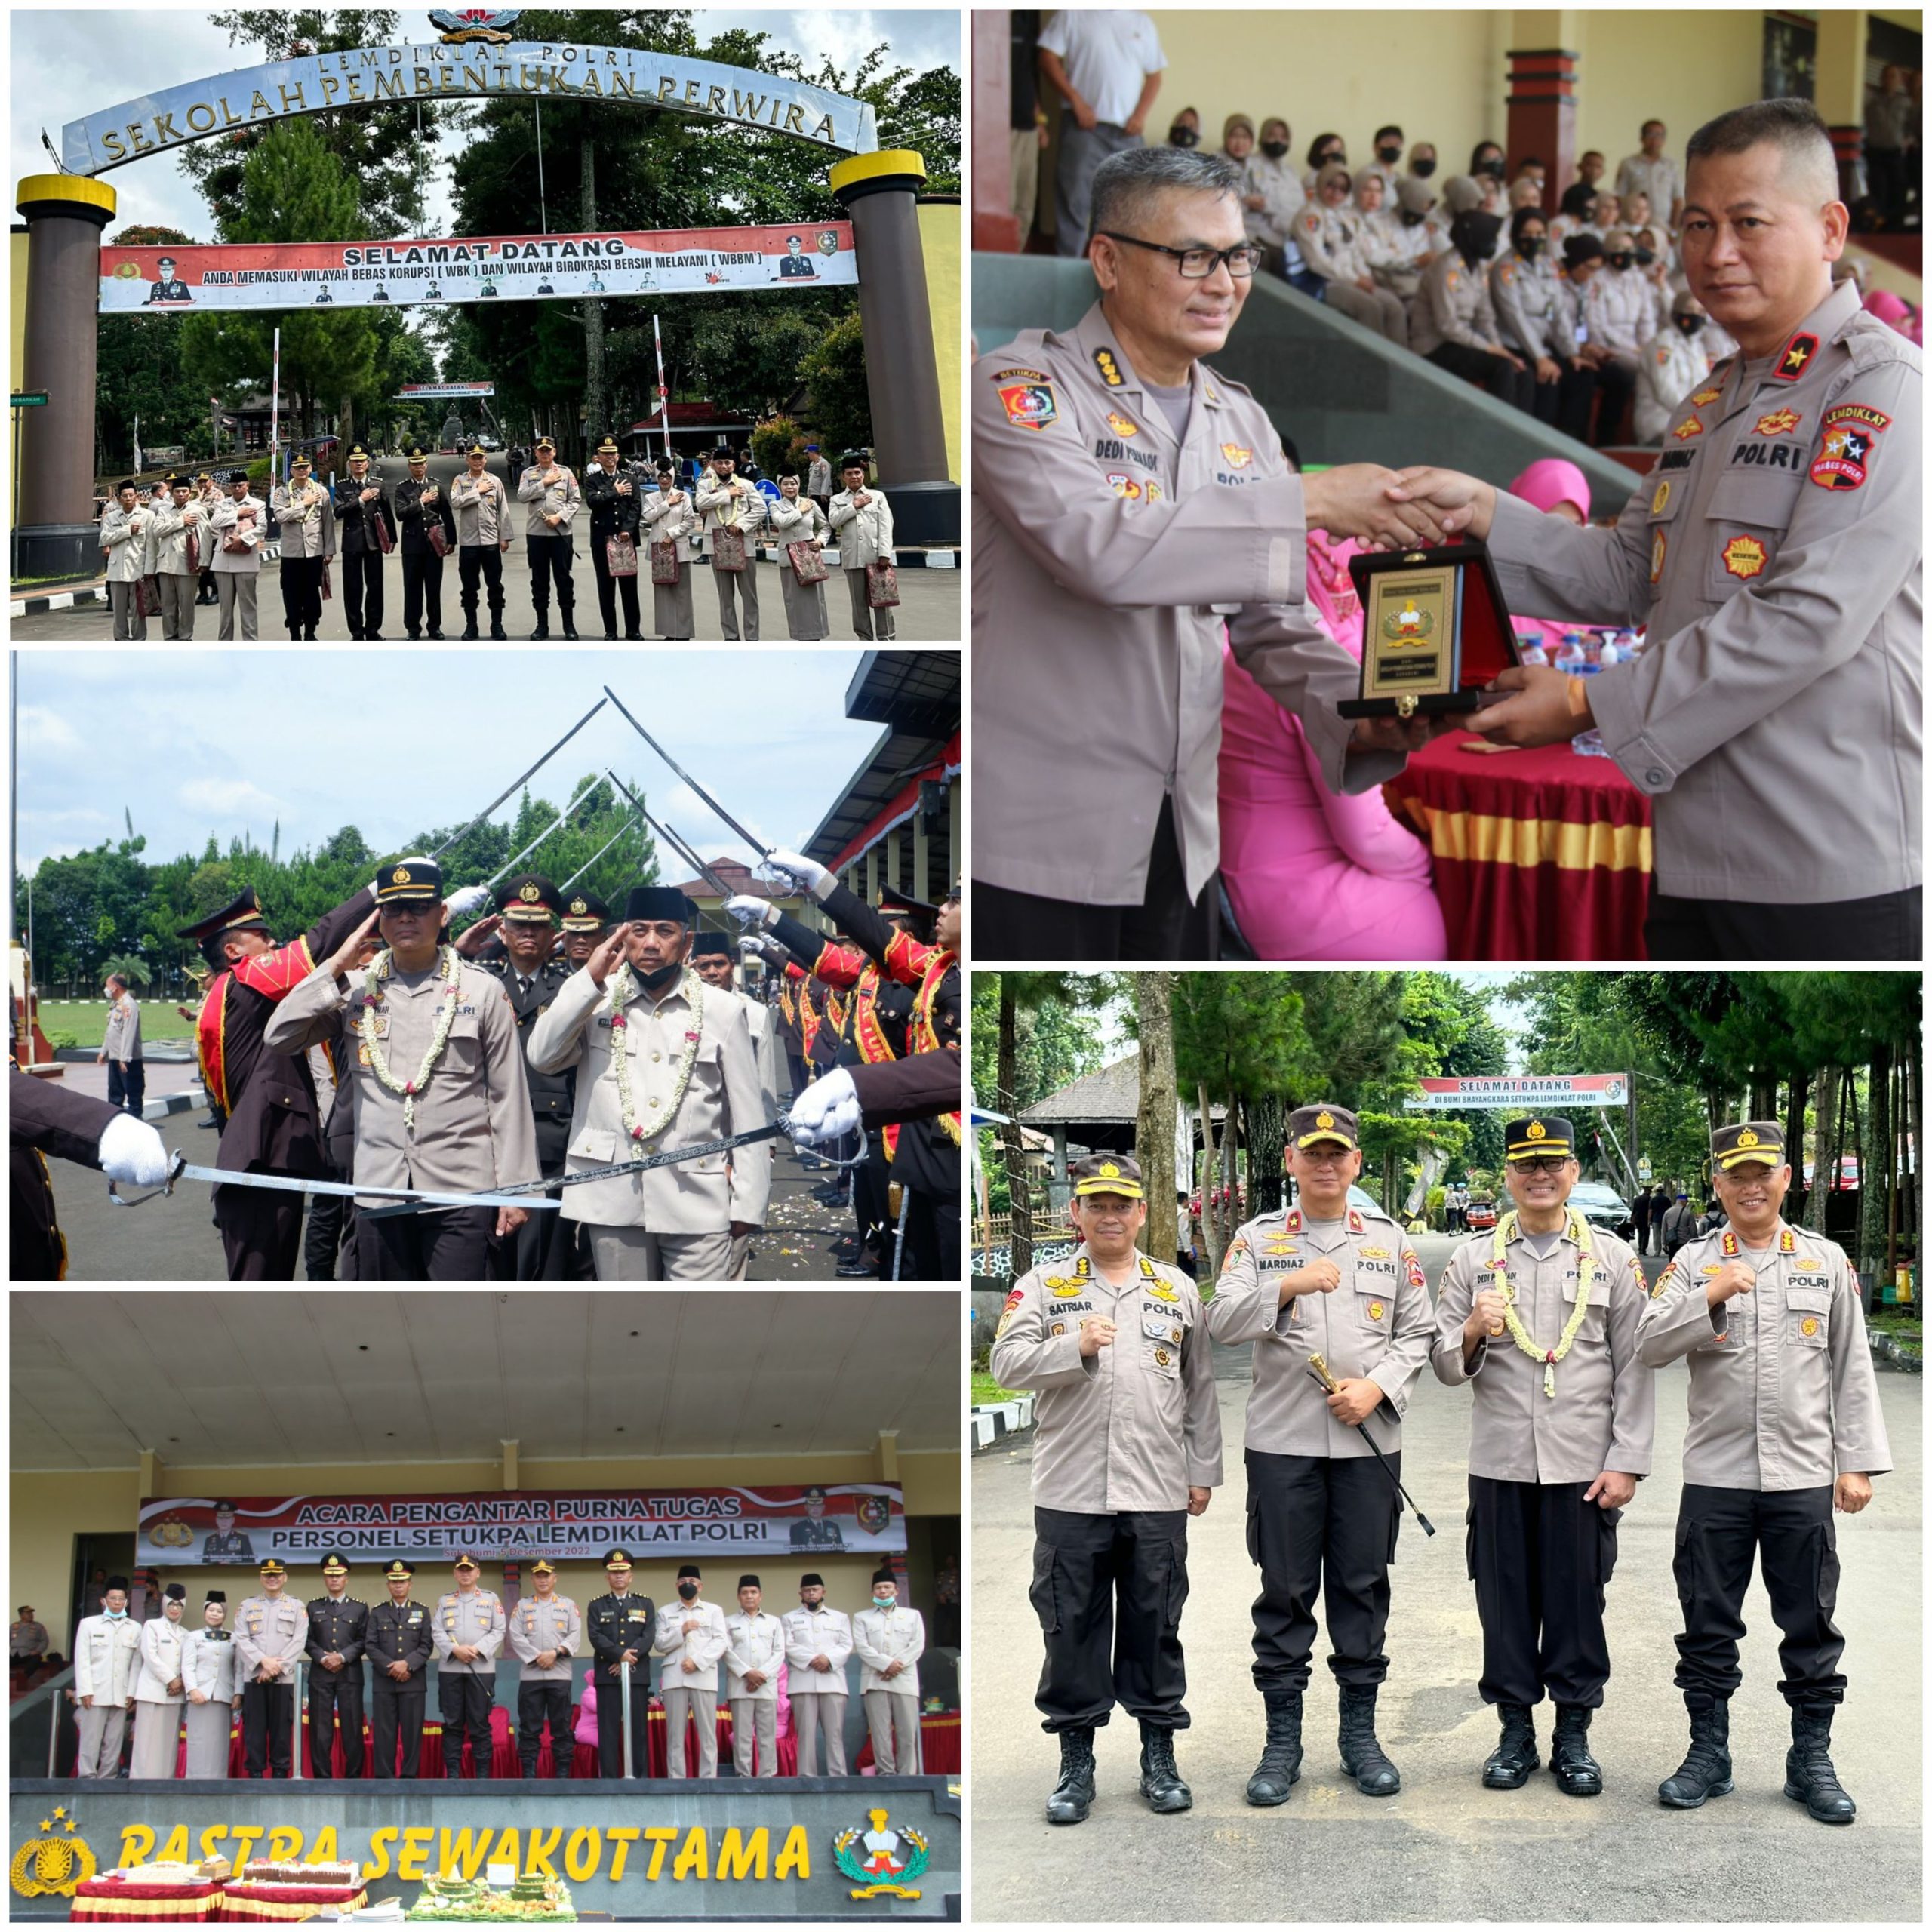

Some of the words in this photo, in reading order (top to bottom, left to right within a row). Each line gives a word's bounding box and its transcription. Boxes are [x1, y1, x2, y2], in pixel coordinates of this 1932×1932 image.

[318, 45, 506, 72] LEMDIKLAT
[542, 46, 632, 67] POLRI
[101, 81, 306, 161] SEKOLAH
[320, 64, 636, 105] PEMBENTUKAN
[658, 75, 837, 143] PERWIRA
[344, 245, 489, 265] SELAMAT
[502, 240, 624, 259] DATANG
[203, 272, 233, 285] ANDA
[238, 270, 297, 284] MEMASUKI
[302, 269, 348, 281] WILAYAH
[352, 268, 386, 280] BEBAS
[389, 266, 435, 279] KORUPSI
[446, 266, 470, 277] WBK
[482, 264, 503, 275] DAN
[506, 262, 552, 275] WILAYAH
[557, 259, 611, 272] BIROKRASI
[615, 257, 651, 269] BERSIH
[656, 254, 708, 268] MELAYANI
[720, 253, 755, 265] WBBM
[1826, 406, 1887, 427] LEMDIKLAT
[1095, 439, 1124, 459] DEDI
[1733, 442, 1802, 470] POLRI
[1841, 463, 1863, 480] POLRI
[436, 1006, 475, 1014] PLRI
[1460, 1080, 1516, 1091] SELAMAT
[1521, 1080, 1571, 1091] DATANG
[1463, 1095, 1509, 1103] BHAYANGKARA
[1540, 1094, 1575, 1103] LEMDIKLAT
[1577, 1094, 1596, 1102] POLRI
[1259, 1259, 1305, 1271] MARDIAZ
[1357, 1260, 1395, 1274] POLRI
[1478, 1273, 1490, 1284] DEDI
[1788, 1276, 1829, 1289] POLRI
[1049, 1301, 1092, 1316] SATRIAR
[1143, 1302, 1183, 1321] POLRI
[298, 1505, 385, 1524] ACARA
[392, 1502, 549, 1523] PENGANTAR
[557, 1499, 648, 1519] PURNA
[649, 1497, 740, 1517] TUGAS
[272, 1531, 408, 1548] PERSONEL
[412, 1526, 528, 1546] SETUKPA
[537, 1524, 685, 1544] LEMDIKLAT
[691, 1521, 768, 1541] POLRI
[509, 1548, 561, 1556] Desember
[565, 1547, 590, 1555] 2022
[118, 1824, 339, 1878] RASTRA
[361, 1824, 811, 1882] SEWAKOTTAMA
